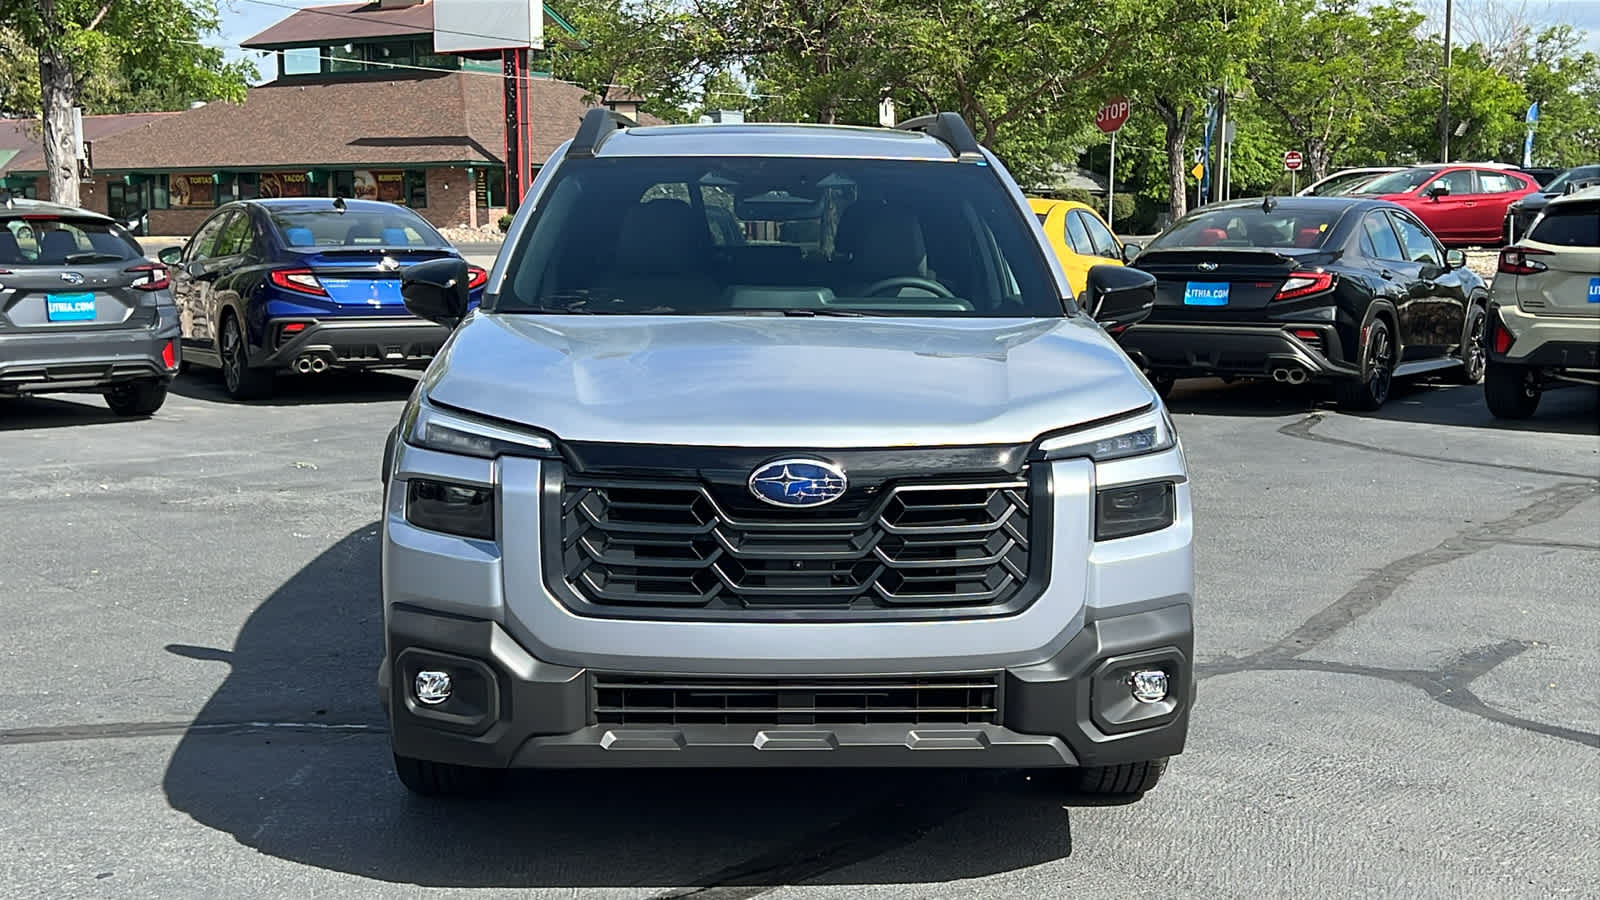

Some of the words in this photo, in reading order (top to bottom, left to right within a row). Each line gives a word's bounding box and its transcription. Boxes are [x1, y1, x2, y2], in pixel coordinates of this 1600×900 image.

[1097, 102, 1127, 121] STOP
[283, 174, 305, 182] TACOS
[1186, 289, 1229, 298] LITHIA.COM
[48, 302, 95, 312] LITHIA.COM
